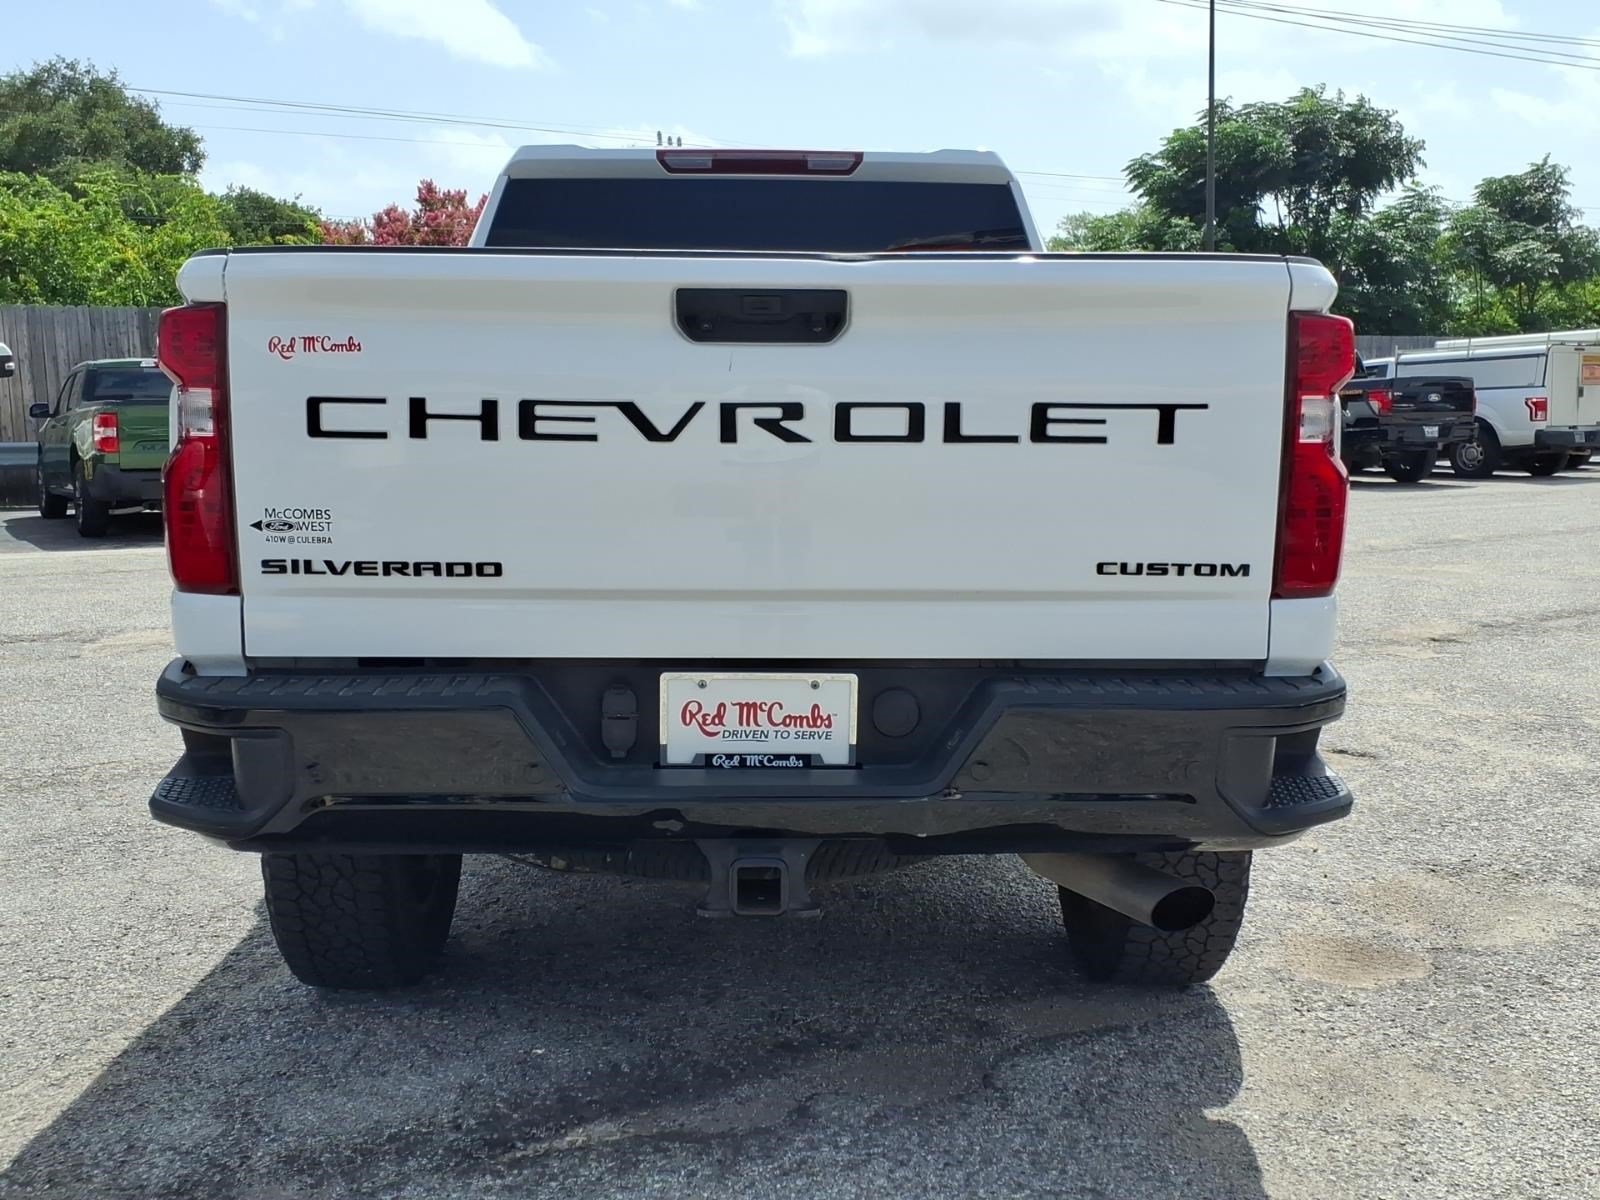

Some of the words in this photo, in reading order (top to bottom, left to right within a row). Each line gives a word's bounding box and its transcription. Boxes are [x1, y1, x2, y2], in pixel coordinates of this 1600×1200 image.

[268, 336, 296, 360] Red
[299, 335, 362, 352] McCombs
[307, 396, 1209, 443] CHEVROLET
[264, 508, 331, 520] McCOMBS
[296, 522, 332, 531] WEST
[297, 536, 332, 544] CULEBRA
[261, 559, 502, 577] SILVERADO
[1096, 562, 1250, 577] CUSTOM
[681, 701, 727, 737] Red
[731, 701, 832, 728] McCombs
[722, 730, 769, 740] DRIVEN
[774, 730, 791, 740] TO
[794, 730, 832, 740] SERVE
[712, 755, 740, 769] Red
[742, 755, 803, 768] McCombs
